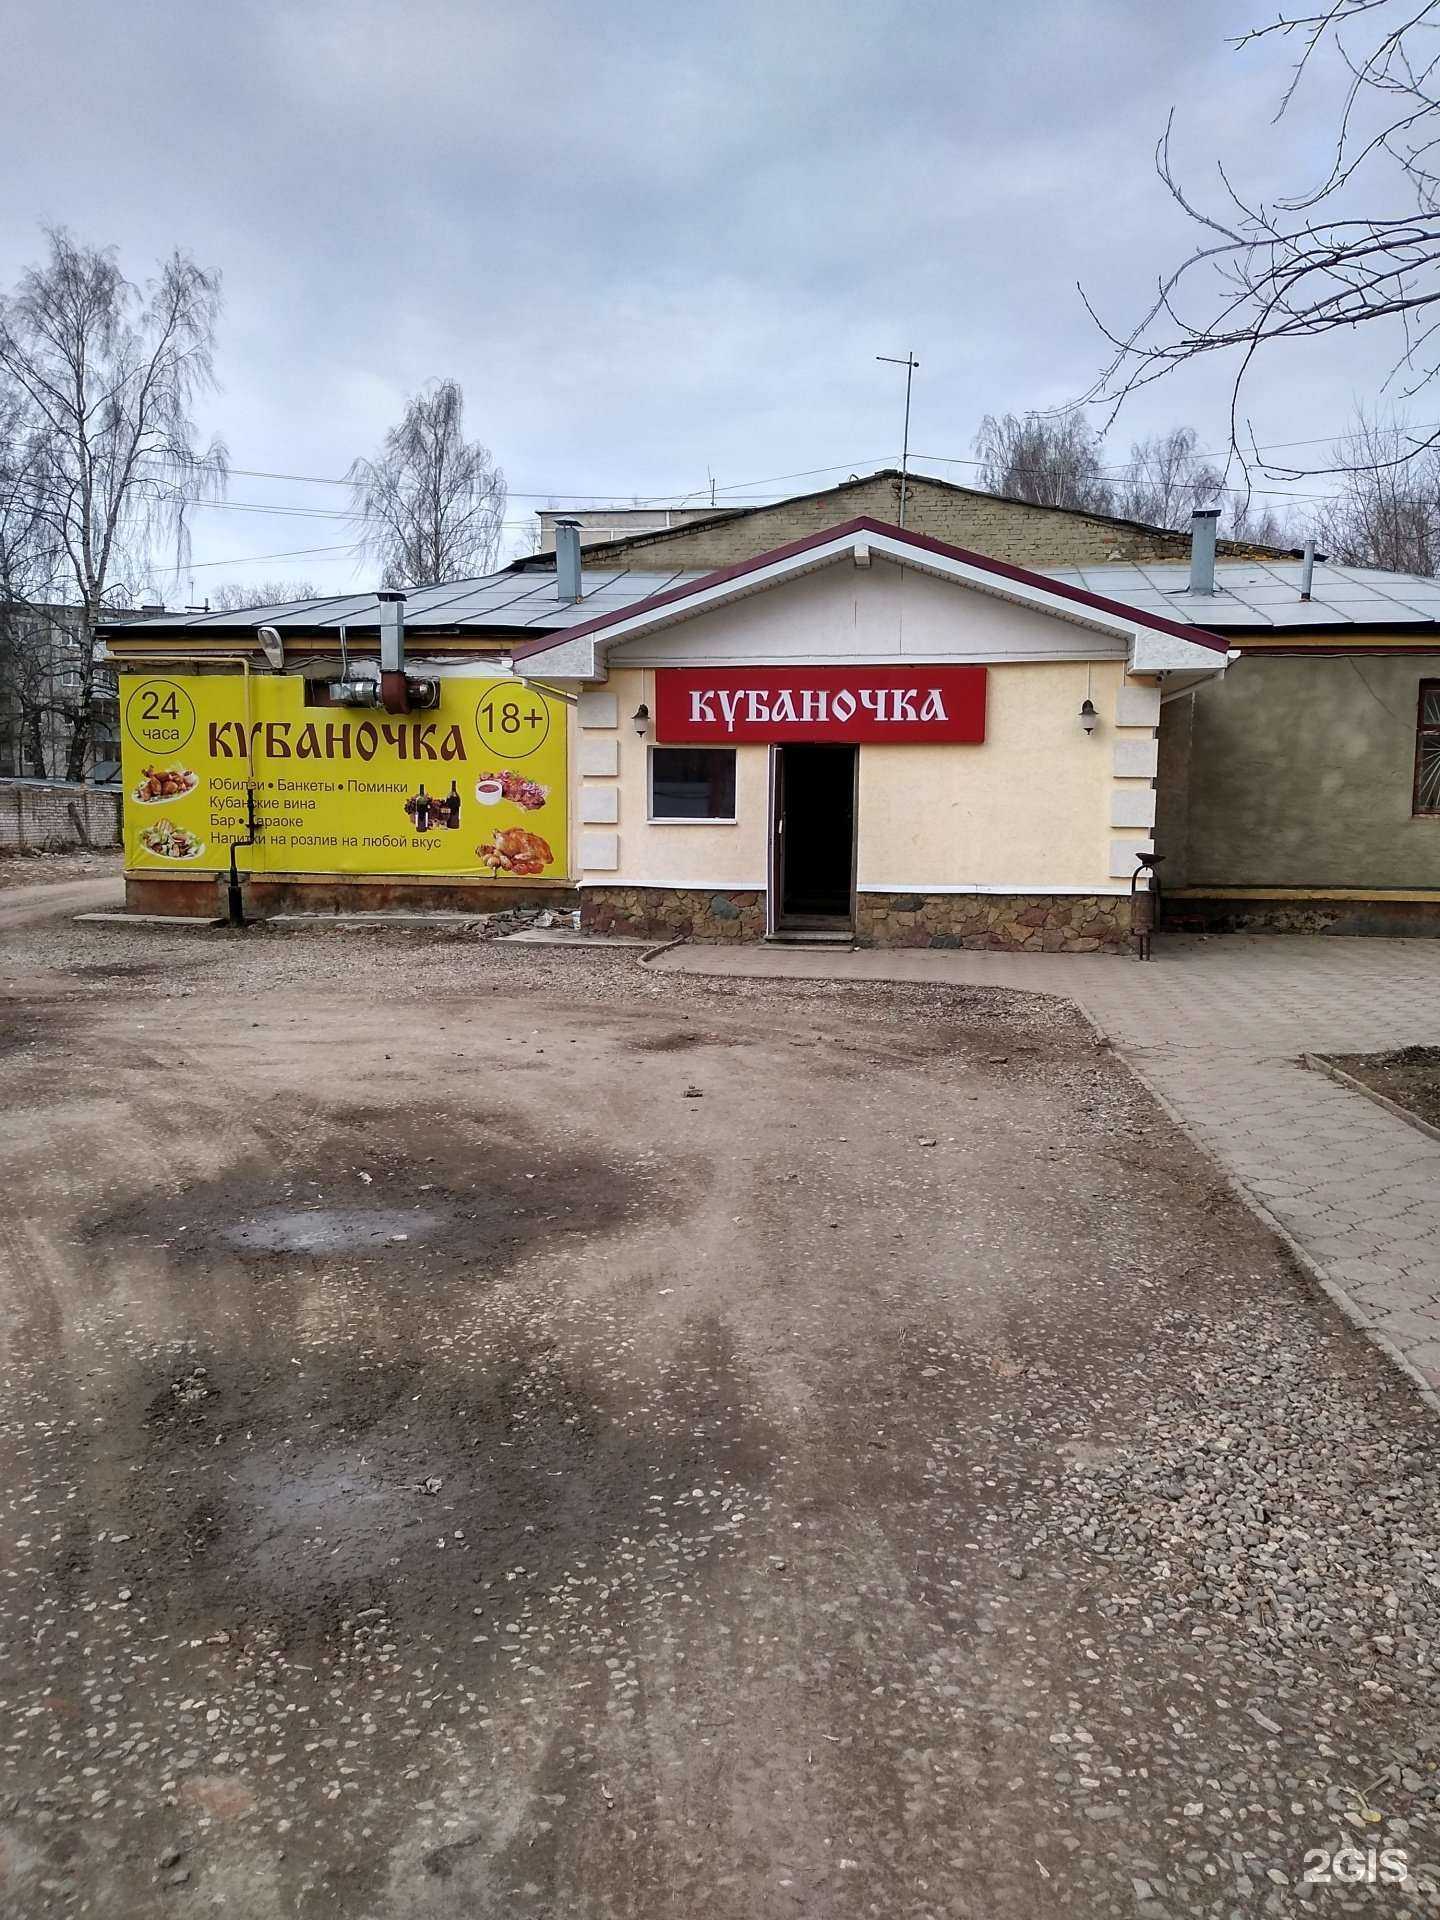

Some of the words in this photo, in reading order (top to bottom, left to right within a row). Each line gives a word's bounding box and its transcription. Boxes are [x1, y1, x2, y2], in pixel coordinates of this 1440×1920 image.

[142, 691, 180, 720] 24
[689, 689, 949, 732] КУБАНОЧКА
[481, 702, 543, 733] 18+
[142, 728, 180, 740] часа
[208, 721, 468, 770] КУБАНОЧКА
[277, 778, 335, 793] Банкеты
[347, 779, 408, 793] Поминки
[284, 800, 316, 810] вина
[210, 814, 236, 829] Бар
[249, 815, 304, 829] араоке
[270, 835, 286, 845] на
[290, 836, 338, 848] розлив
[342, 837, 358, 847] на
[362, 835, 407, 848] любой
[411, 838, 442, 851] вкус
